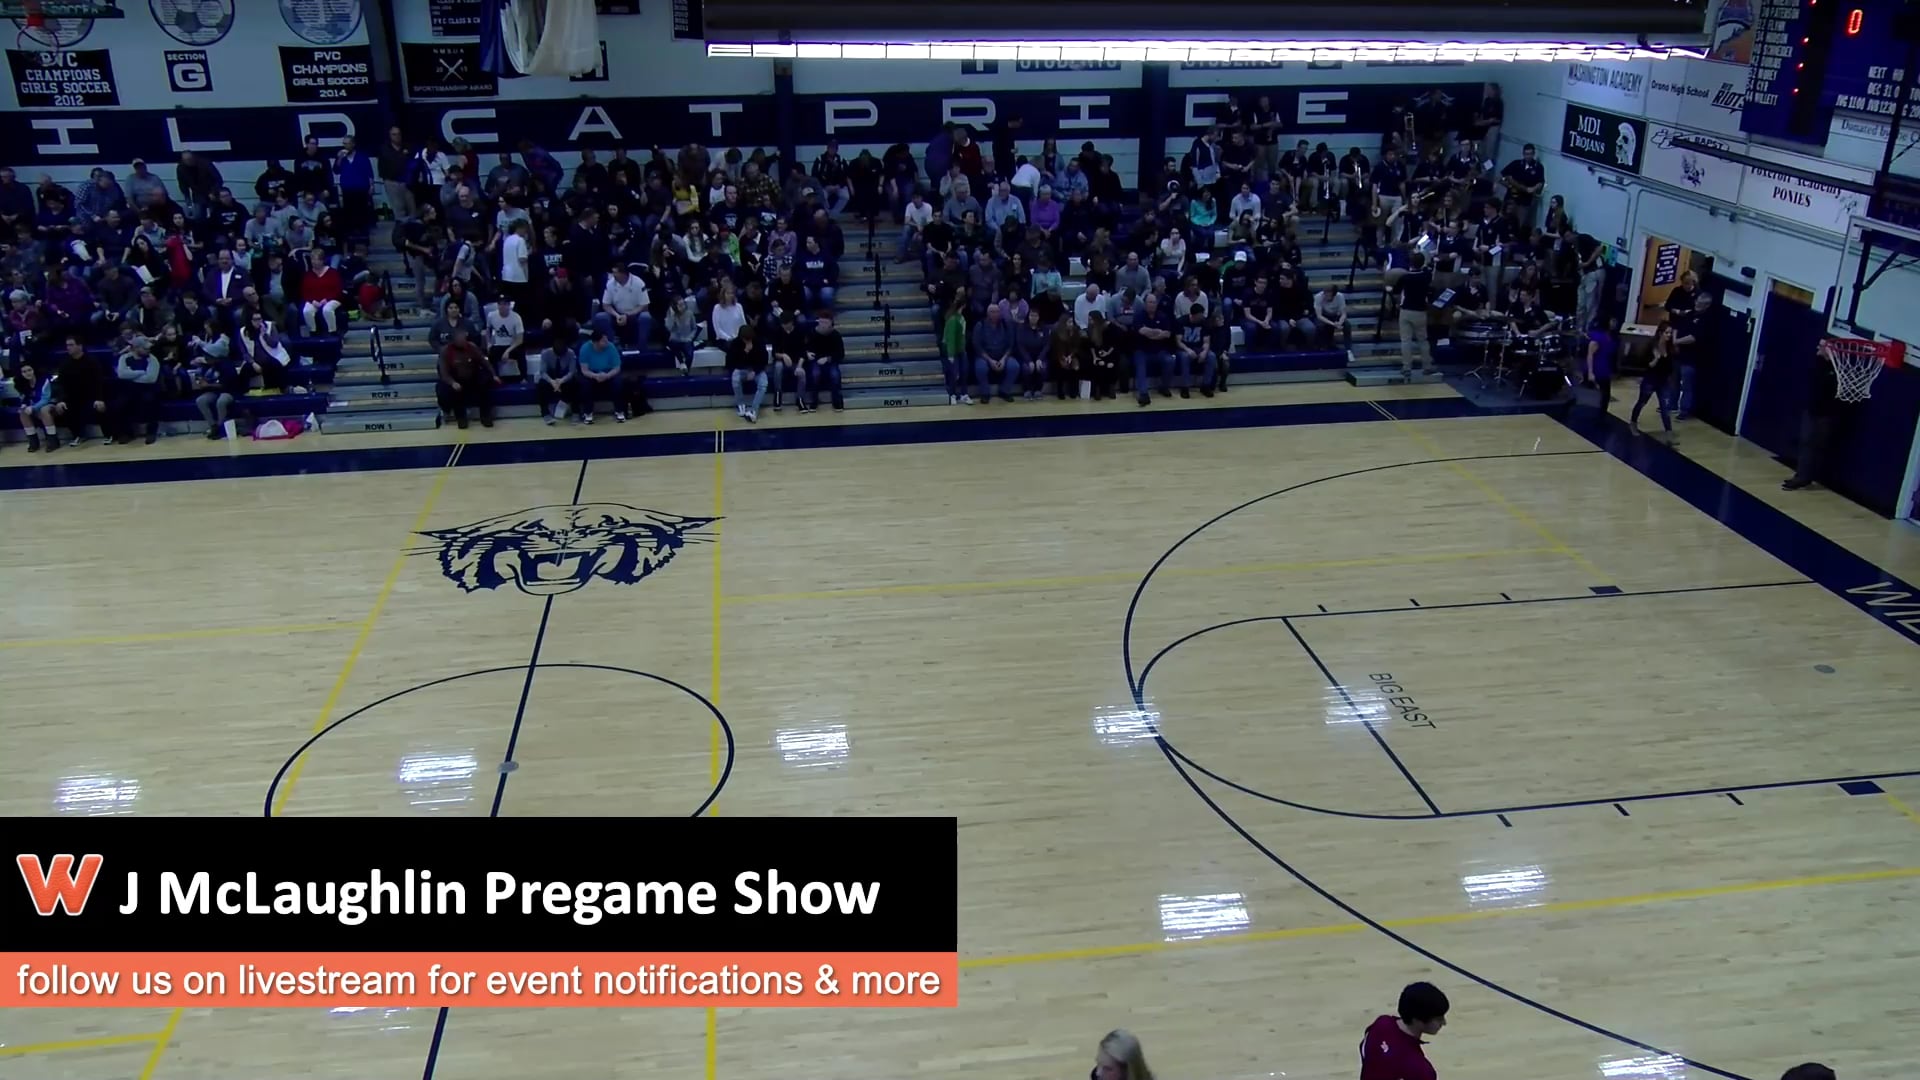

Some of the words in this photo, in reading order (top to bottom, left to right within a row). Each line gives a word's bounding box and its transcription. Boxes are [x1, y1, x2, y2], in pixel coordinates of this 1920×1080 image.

[1847, 9, 1864, 34] 0
[167, 53, 205, 61] SECTION
[314, 51, 341, 61] PVC
[25, 69, 101, 81] CHAMPIONS
[173, 63, 207, 88] G
[292, 64, 368, 75] CHAMPIONS
[1568, 64, 1609, 87] WASHINGTON
[1610, 70, 1644, 93] ACADEMY
[21, 82, 58, 94] GIRLS
[63, 81, 111, 94] SOCCER
[292, 77, 325, 87] GIRLS
[327, 76, 369, 86] SOCCER
[1651, 80, 1670, 92] Orono
[1671, 82, 1685, 96] High
[1686, 84, 1710, 98] School
[54, 95, 85, 106] 2012
[319, 89, 347, 98] 2014
[1712, 90, 1745, 108] RIOTS
[1577, 115, 1601, 136] MDI
[1841, 119, 1878, 136] Donated
[1569, 131, 1606, 154] TROJANS
[1772, 186, 1811, 207] PONIES
[1369, 672, 1403, 694] BIG
[1389, 696, 1437, 730] EAST
